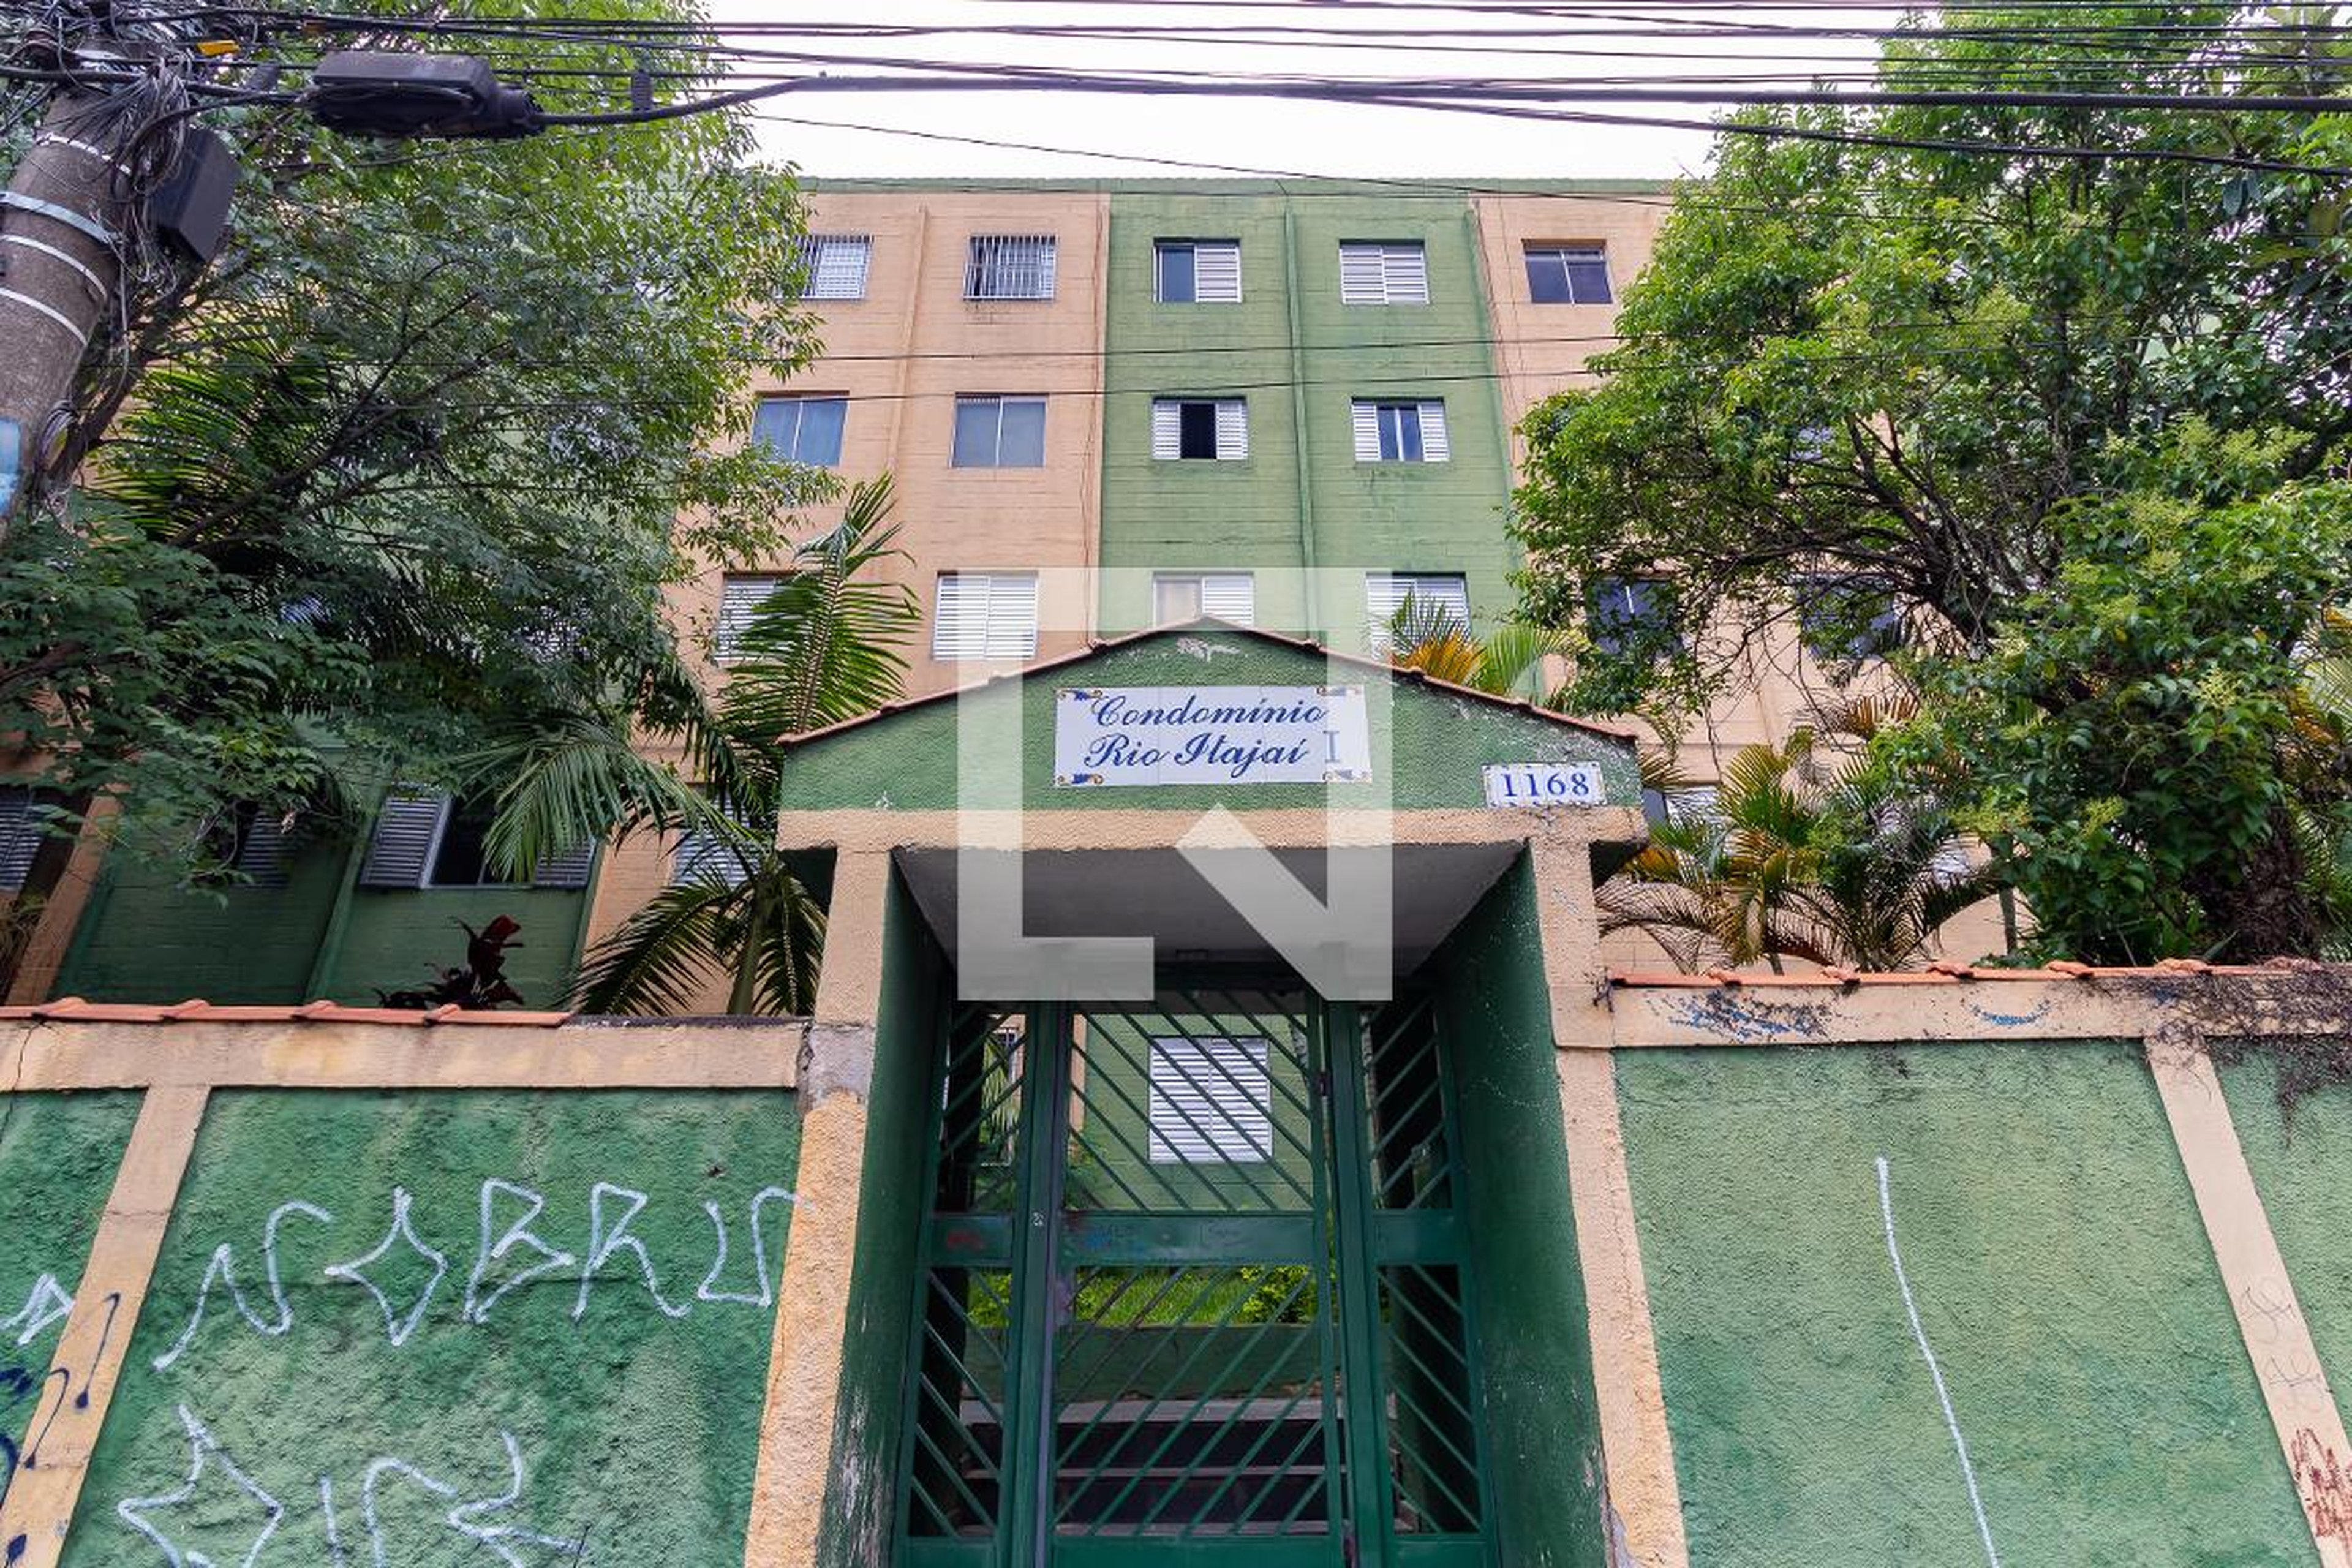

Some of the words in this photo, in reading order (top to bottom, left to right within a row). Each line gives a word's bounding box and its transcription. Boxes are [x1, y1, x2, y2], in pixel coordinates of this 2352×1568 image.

[1091, 693, 1326, 728] Condomínio
[1084, 733, 1170, 767] Rio
[1174, 731, 1310, 778] Itajaí
[1501, 772, 1589, 797] 1168
